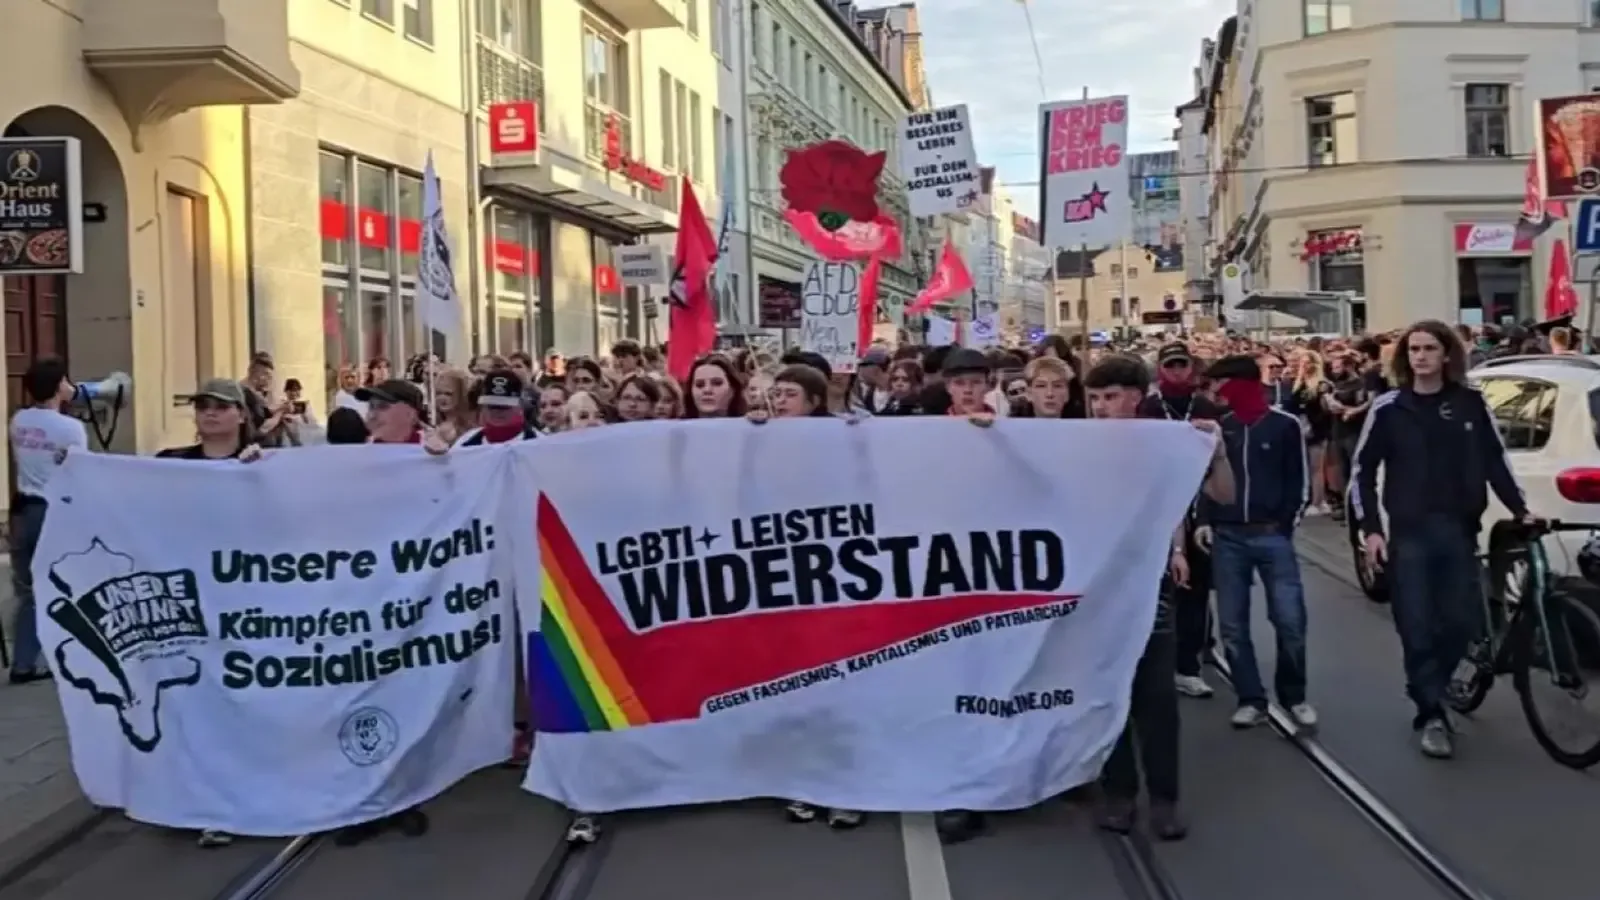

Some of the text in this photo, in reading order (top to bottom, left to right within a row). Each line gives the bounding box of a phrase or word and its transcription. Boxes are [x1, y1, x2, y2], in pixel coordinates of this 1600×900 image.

[1053, 100, 1124, 126] KRIEG
[906, 122, 962, 139] BESSERES
[918, 136, 955, 150] LEBEN
[1051, 123, 1102, 149] DEM
[942, 160, 967, 173] DEN
[1048, 143, 1121, 174] KRIEG
[937, 188, 953, 198] US
[0, 200, 52, 217] Haus
[804, 263, 857, 294] AFD
[803, 320, 838, 341] Nein
[732, 503, 876, 549] LEISTEN
[212, 550, 377, 583] Unsere
[618, 529, 1065, 630] WIDERSTAND
[219, 607, 371, 644] Kämpfen
[381, 596, 432, 631] für
[444, 579, 499, 614] den
[222, 614, 501, 689] Sozialismus!
[706, 600, 1079, 714] GEGEN FASCHISMUS, KAPITALISMUS UND PATRIARCHAT
